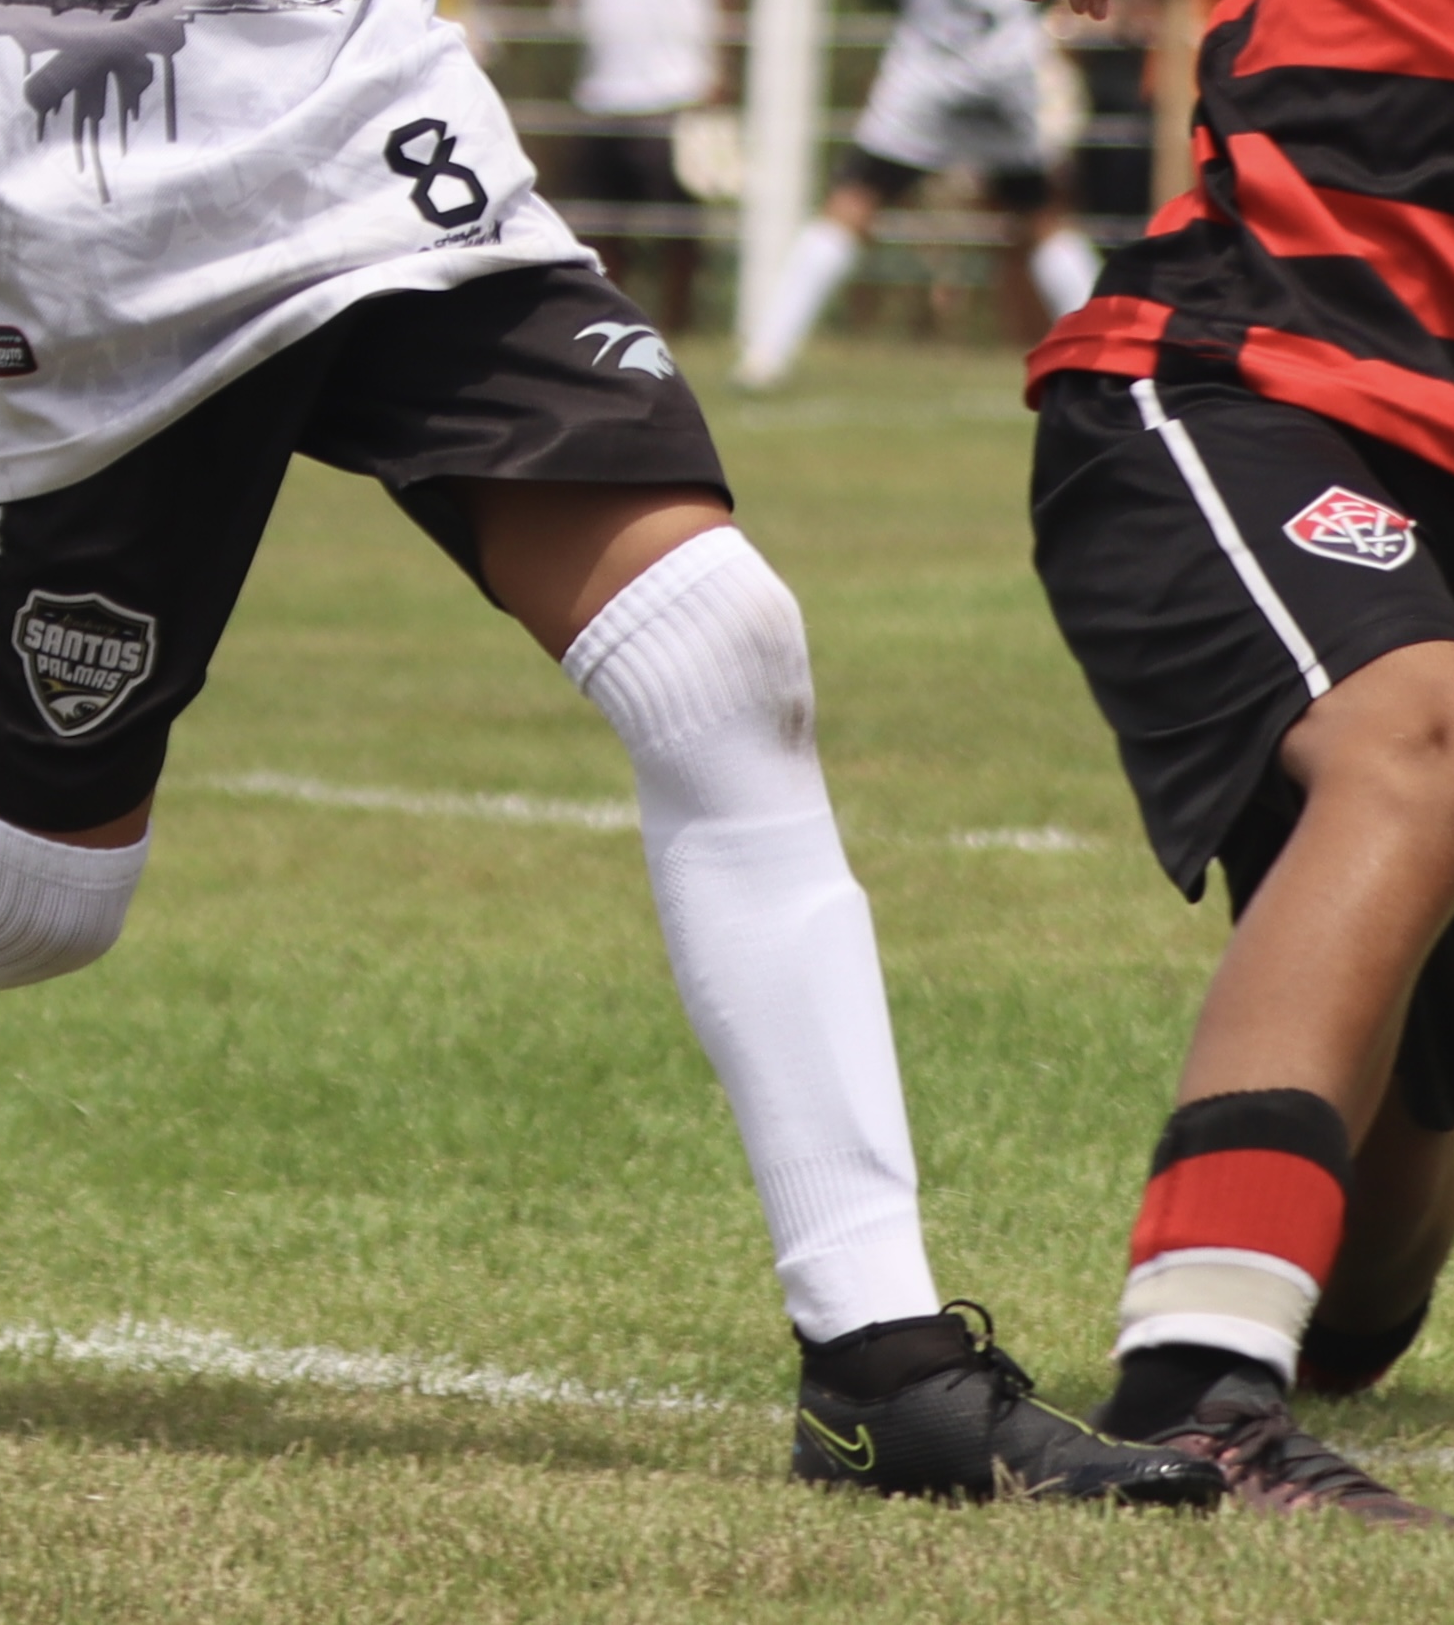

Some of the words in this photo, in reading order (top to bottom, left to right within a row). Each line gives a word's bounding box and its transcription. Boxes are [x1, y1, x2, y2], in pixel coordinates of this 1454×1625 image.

[384, 118, 489, 230] 8
[22, 618, 143, 673] SANTOS
[37, 653, 123, 692] PALMAS
